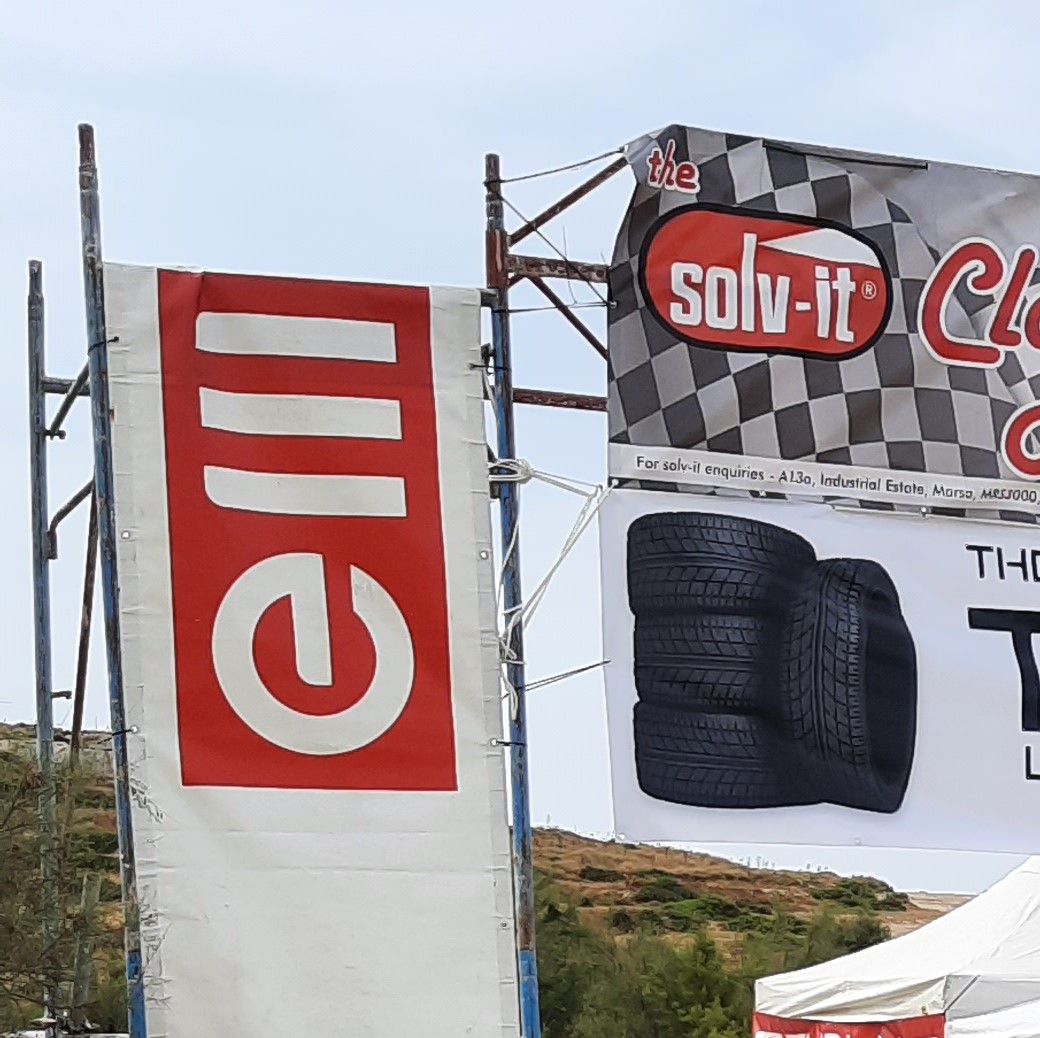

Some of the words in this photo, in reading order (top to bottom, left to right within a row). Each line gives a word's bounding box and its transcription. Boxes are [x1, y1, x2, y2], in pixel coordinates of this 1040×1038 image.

[646, 140, 699, 191] the
[669, 232, 856, 343] solv-it
[636, 456, 660, 470] For
[663, 457, 701, 474] solv-it
[704, 464, 765, 480] enquiries
[820, 472, 881, 491] Industrial
[886, 480, 927, 499] Estate,
[932, 483, 977, 502] Marsa,
